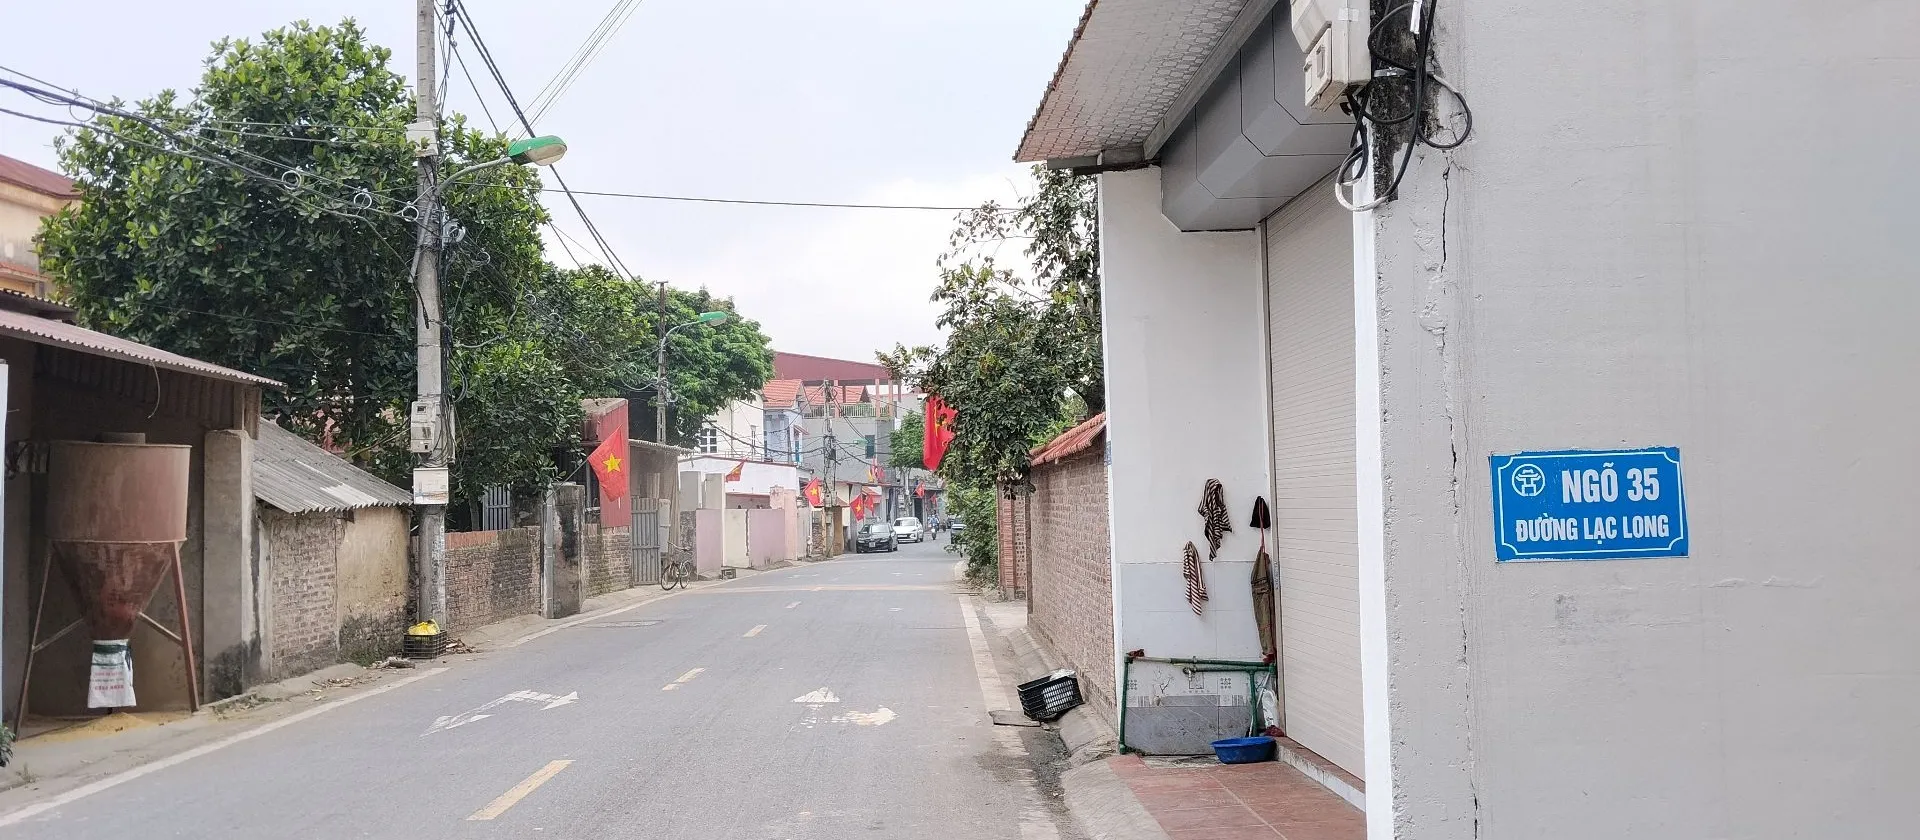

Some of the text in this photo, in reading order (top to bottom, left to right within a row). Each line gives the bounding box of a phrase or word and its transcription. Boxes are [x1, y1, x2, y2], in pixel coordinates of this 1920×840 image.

[1561, 462, 1660, 503] NGÕ 35
[1515, 513, 1670, 545] ĐƯỜNG LẠC LONG
